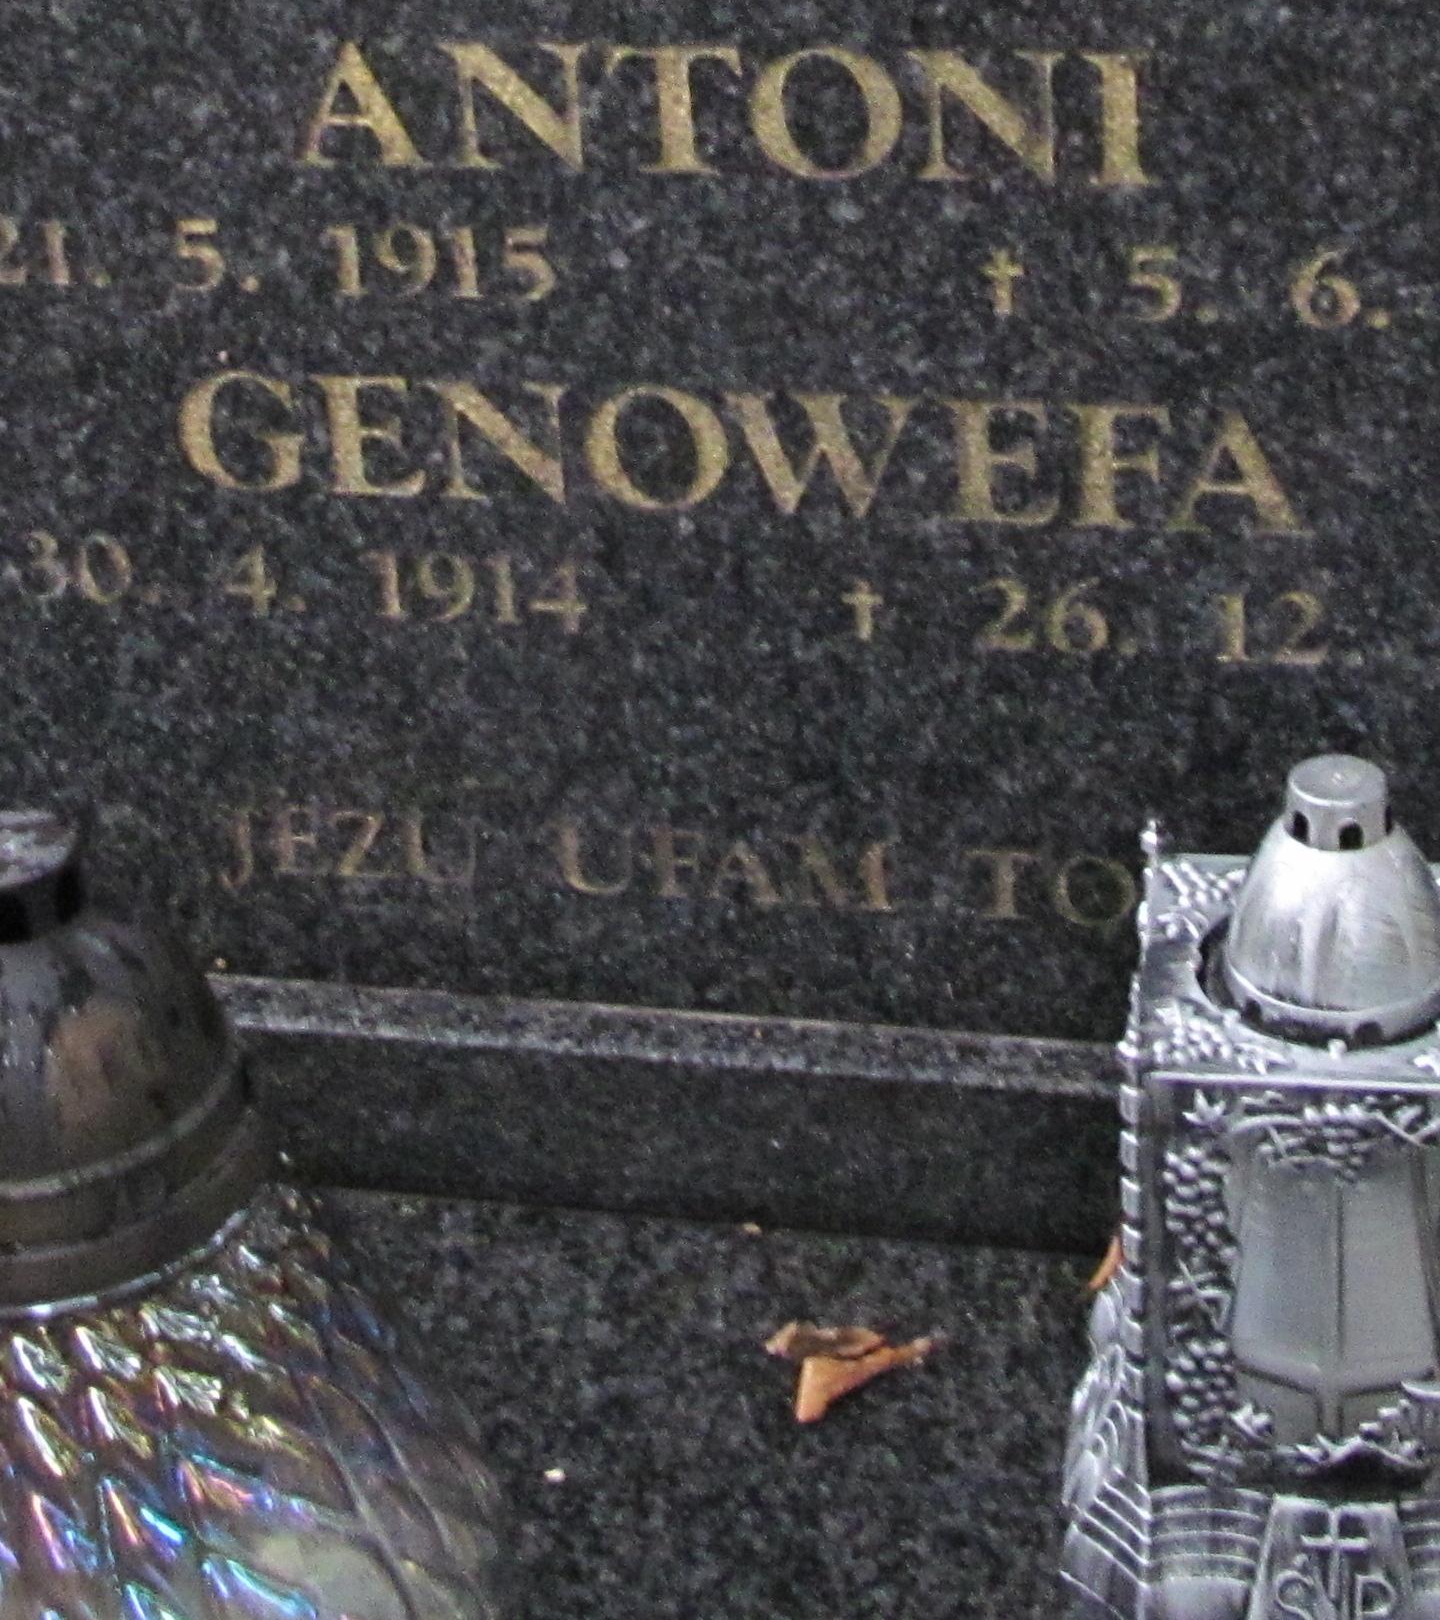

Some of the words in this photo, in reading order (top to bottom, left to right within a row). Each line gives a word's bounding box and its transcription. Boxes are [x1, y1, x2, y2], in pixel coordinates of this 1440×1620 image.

[301, 40, 1150, 186] ANTONI
[172, 218, 261, 295] 5.
[323, 222, 558, 302] 1915
[1127, 245, 1218, 325] 5.
[1289, 246, 1391, 331] 6.
[178, 370, 1312, 539] GENOWEFA
[20, 532, 159, 607] 30.
[218, 545, 306, 618] 4.
[368, 548, 589, 636] 1914
[980, 578, 1138, 658] 26.
[218, 806, 479, 894] JEZU
[556, 818, 901, 914] UFAM
